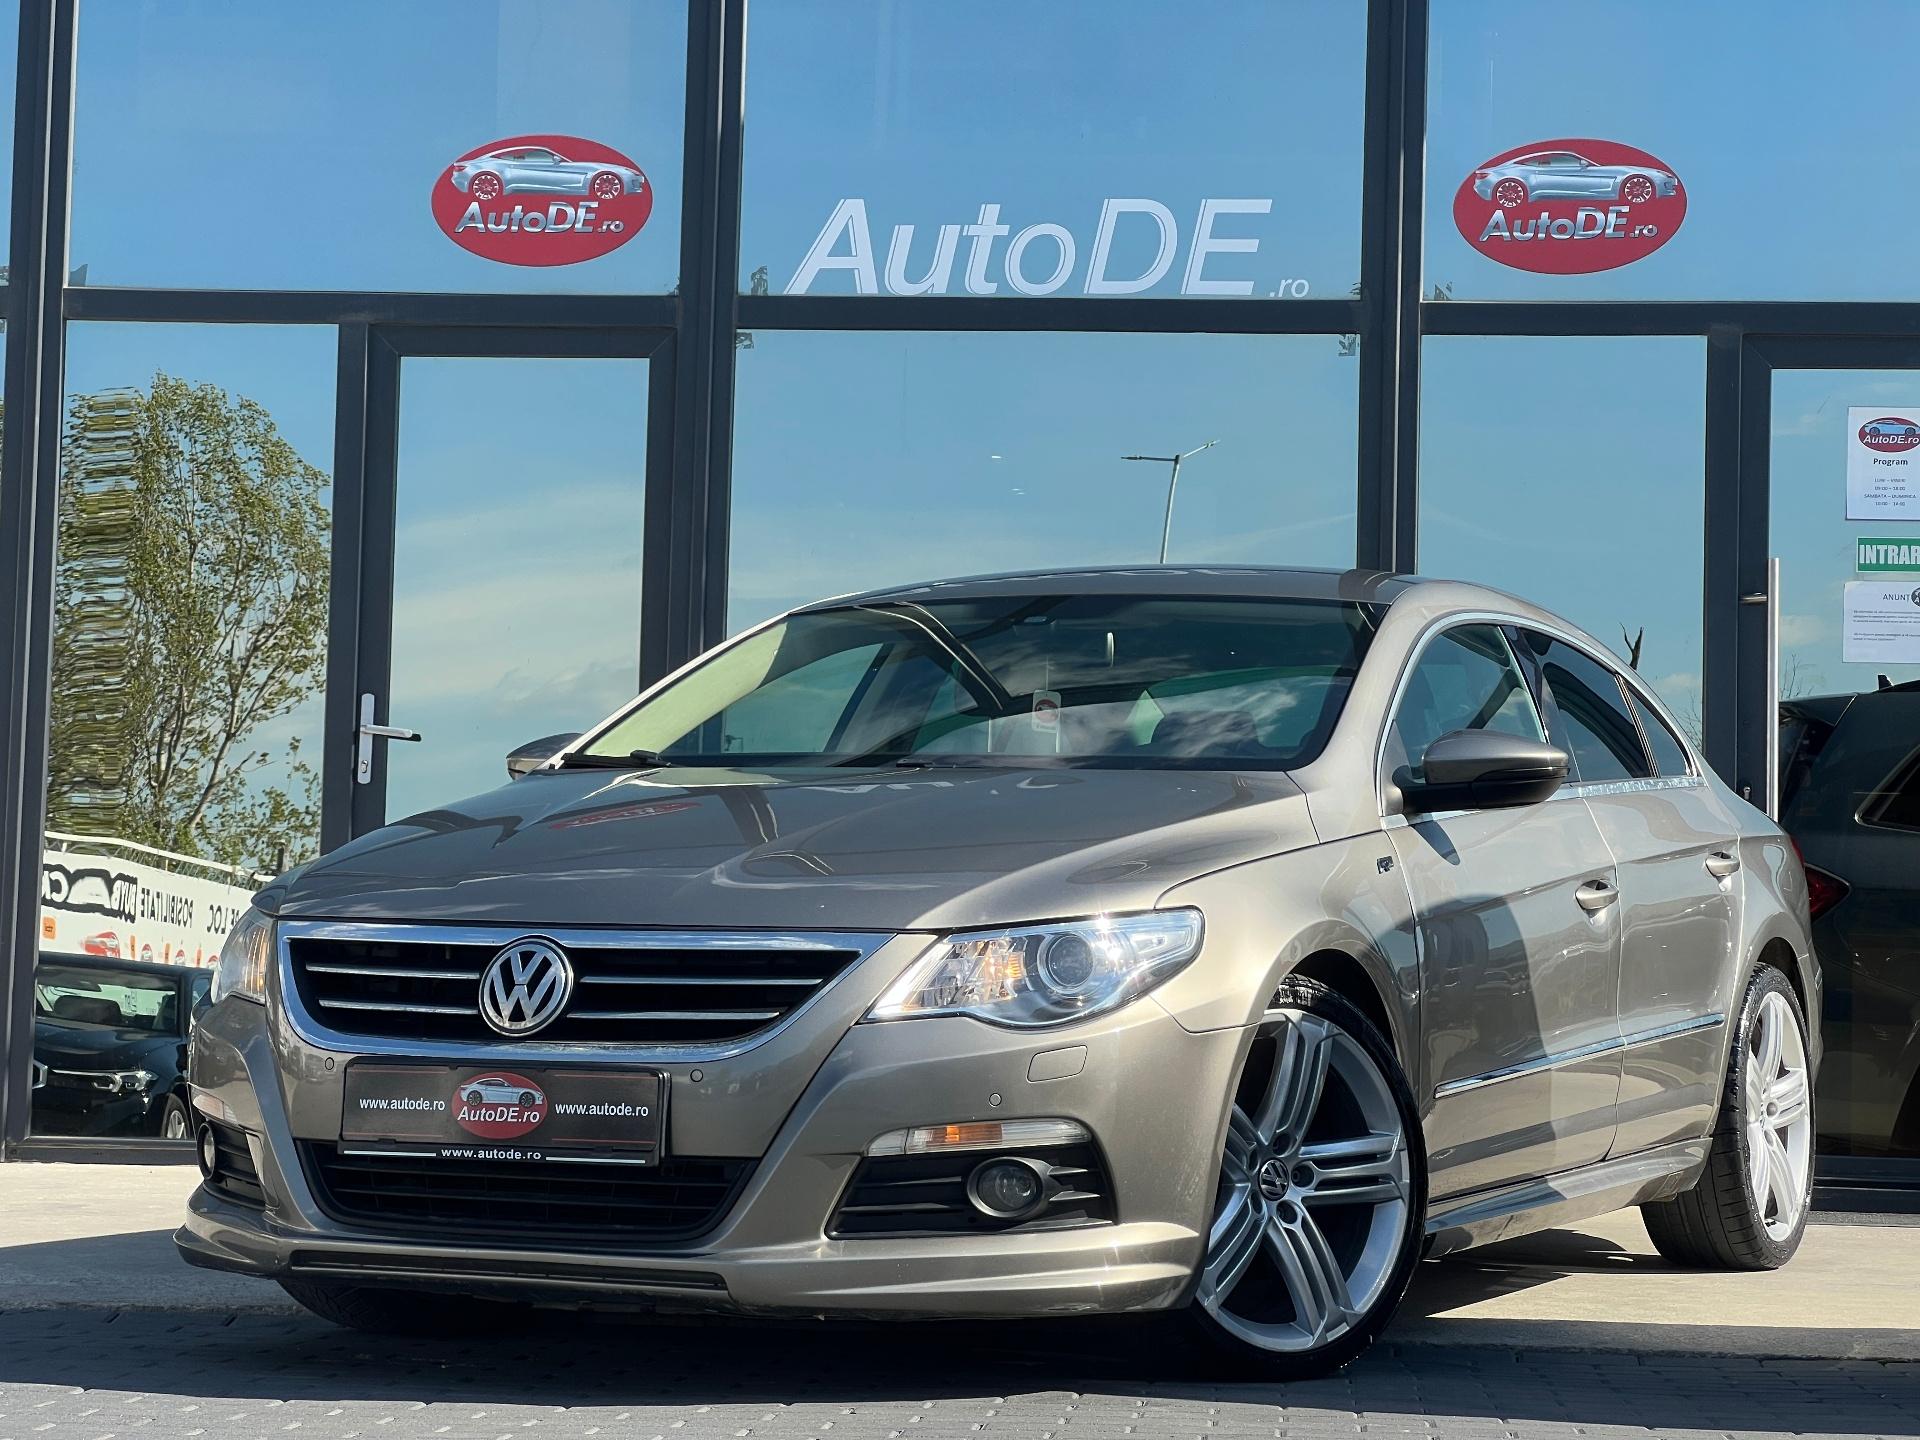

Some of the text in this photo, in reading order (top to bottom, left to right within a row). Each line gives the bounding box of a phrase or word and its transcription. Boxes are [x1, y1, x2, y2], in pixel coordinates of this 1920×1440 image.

[1873, 457, 1908, 467] Program
[359, 1096, 649, 1124] www.autode.ro AutoDE.ro www.autode.ro
[441, 1147, 542, 1161] www.autode.ro
